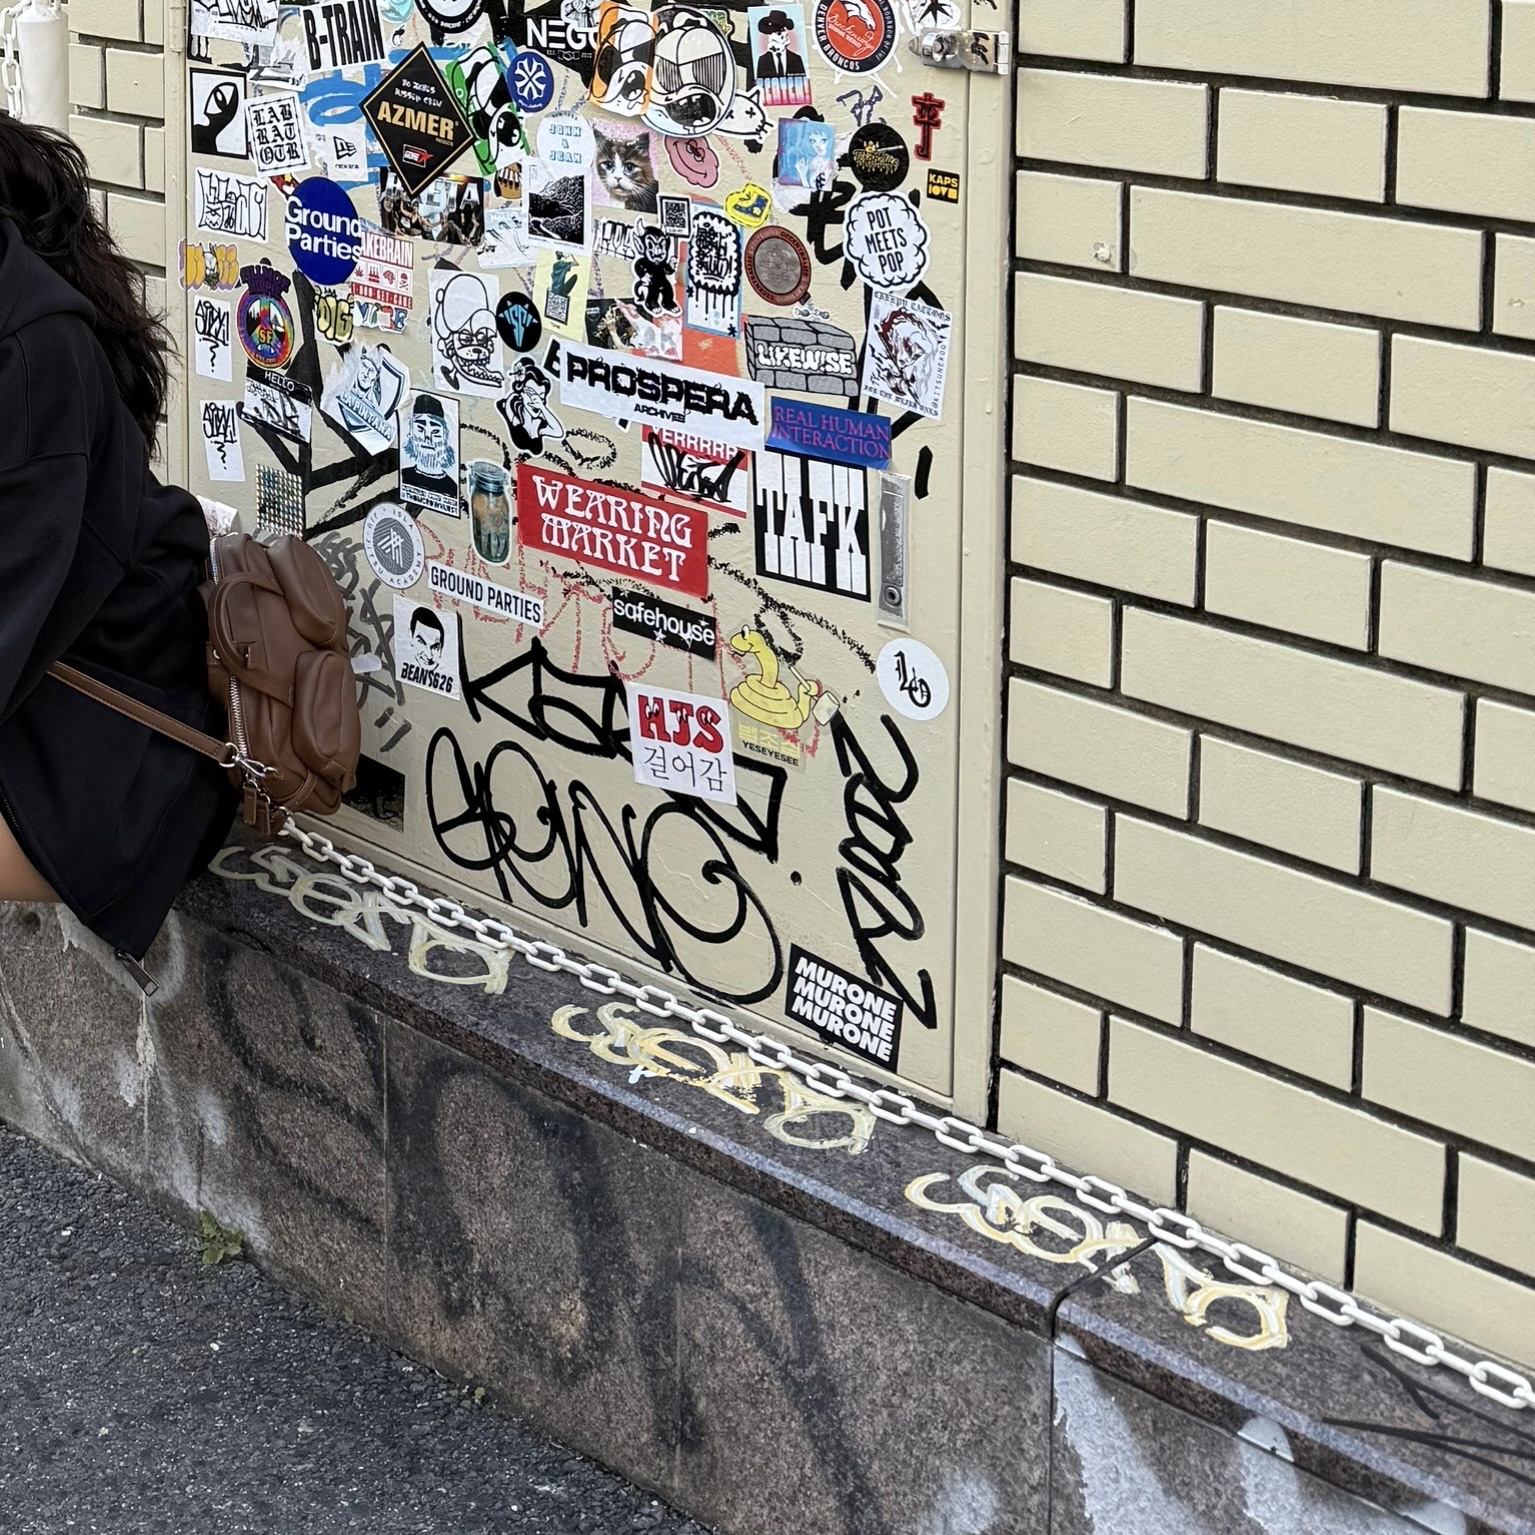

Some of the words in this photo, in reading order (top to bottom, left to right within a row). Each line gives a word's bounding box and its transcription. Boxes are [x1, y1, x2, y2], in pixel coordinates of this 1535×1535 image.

[815, 5, 828, 42] DENVER
[824, 46, 861, 71] BRONCOS
[253, 103, 293, 127] LAB
[377, 101, 454, 140] AZMER
[256, 123, 296, 146] RAT
[929, 173, 958, 188] KAPS
[286, 195, 362, 236] Ground
[866, 207, 892, 231] POT
[285, 223, 363, 262] Parties
[864, 227, 907, 254] MEETS
[878, 251, 904, 275] POP
[259, 328, 273, 344] SF
[757, 344, 853, 374] LIKEWISE
[265, 371, 294, 391] HELLO
[567, 352, 759, 425] PROSPERA
[771, 423, 891, 460] INTERACTION
[774, 406, 817, 428] REAL
[821, 415, 889, 442] HUMAN
[532, 475, 693, 548] WEARING
[541, 513, 686, 582] MARKET
[389, 551, 422, 585] ACADEMY
[431, 566, 483, 602] GROUND
[488, 587, 541, 624] PARTIES
[613, 599, 715, 646] safehouse
[401, 662, 454, 693] BEANS626
[638, 694, 724, 754] HJS
[742, 740, 799, 767] YESEYESEE
[794, 956, 897, 1022] MURONE
[793, 976, 895, 1042] MURONE
[791, 995, 893, 1062] MURONE
